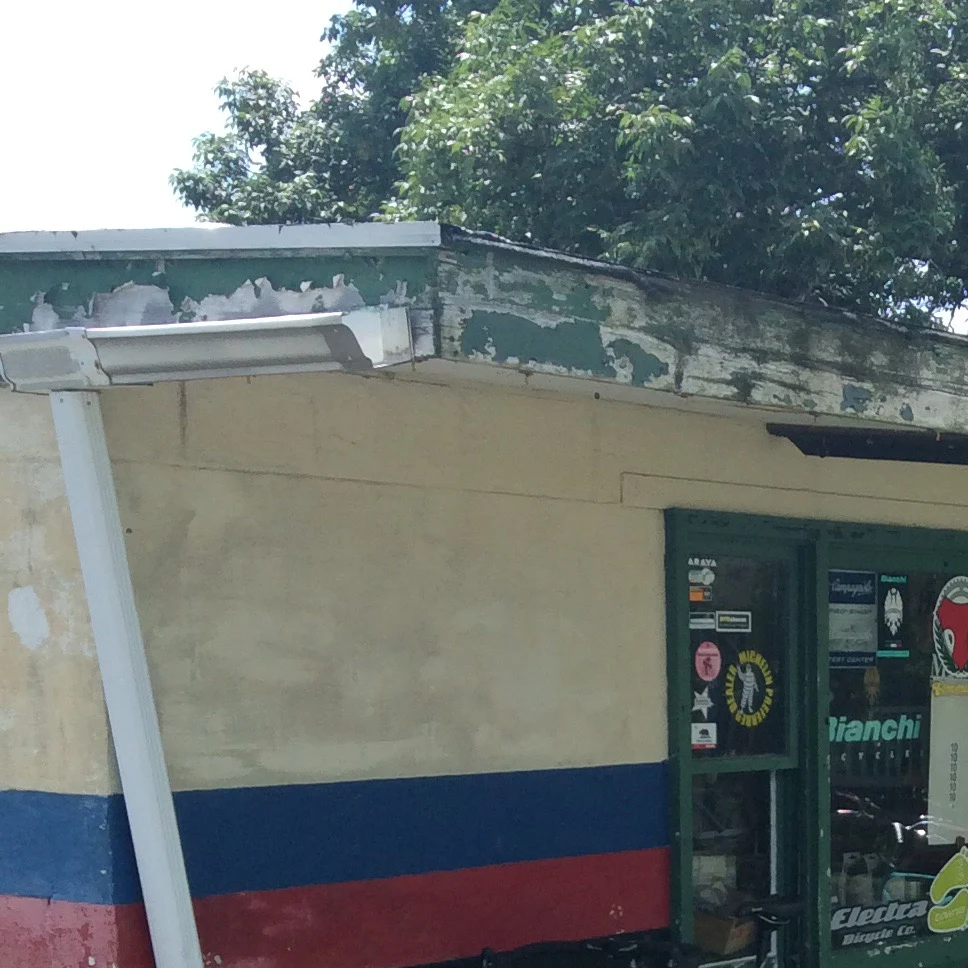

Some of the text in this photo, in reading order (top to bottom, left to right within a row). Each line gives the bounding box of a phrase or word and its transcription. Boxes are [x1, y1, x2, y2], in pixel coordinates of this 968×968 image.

[688, 558, 717, 567] ARAYA
[738, 650, 774, 686] MICHELIN
[831, 900, 929, 930] Electra
[842, 925, 916, 946] Bicycle Co.
